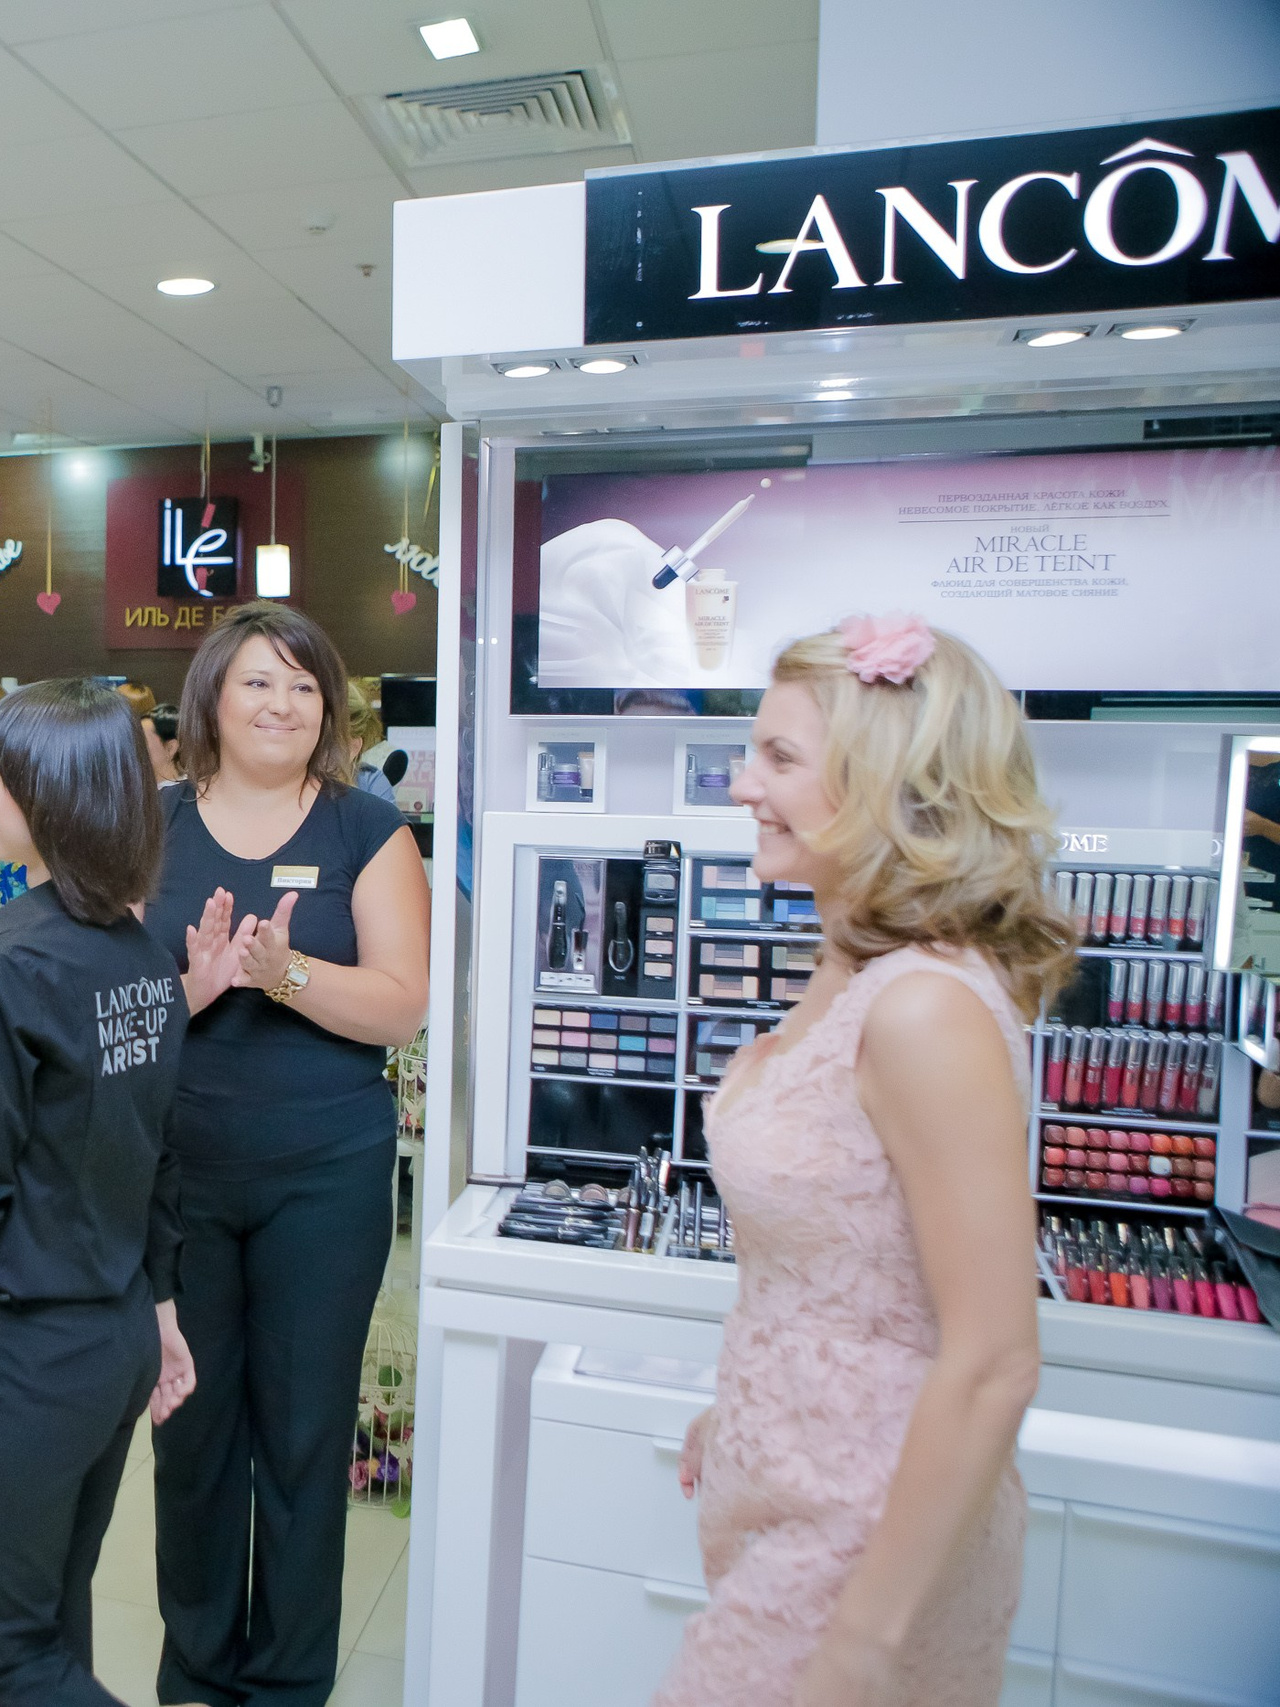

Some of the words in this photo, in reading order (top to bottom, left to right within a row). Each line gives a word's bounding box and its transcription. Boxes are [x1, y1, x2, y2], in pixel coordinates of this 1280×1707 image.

[937, 492, 1030, 503] ПЕРВОЗДАННАЯ
[1033, 490, 1087, 500] КРАСОТА
[898, 505, 971, 515] НЕВЕСОМОЕ
[1092, 501, 1117, 510] КАК
[1010, 524, 1050, 533] НОВЫЙ
[974, 534, 1088, 553] MIRACLE
[946, 556, 988, 573] AIR
[995, 555, 1029, 573] DE
[1034, 554, 1116, 572] TEINT
[931, 580, 971, 588] ФЛЮИД
[974, 579, 995, 588] ДЛЯ
[998, 578, 1088, 588] СОВЕРШЕНСТВА
[940, 589, 1013, 598] СОЗДАЮЩИЙ
[1016, 589, 1068, 598] МАТОВОЕ
[1071, 588, 1119, 597] СИЯНИЕ
[125, 606, 170, 628] ИЛЬ
[174, 606, 205, 630] ДЕ
[95, 976, 175, 1019] LANCÔME
